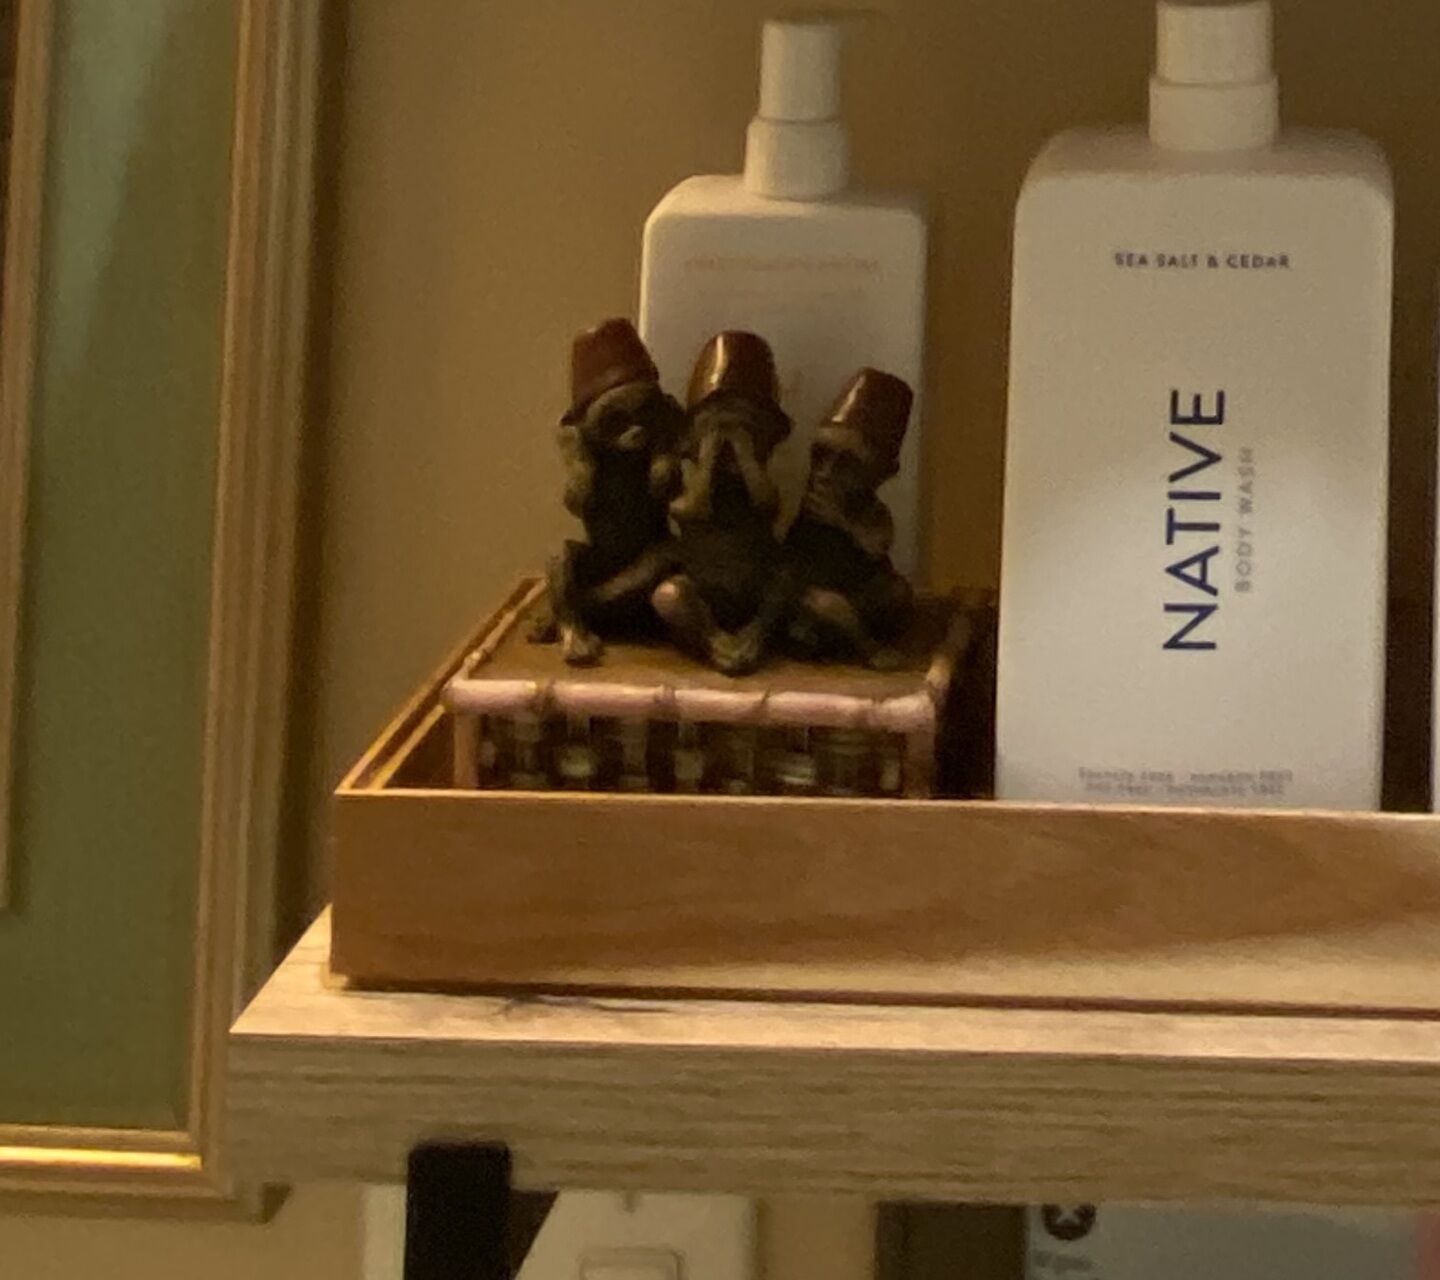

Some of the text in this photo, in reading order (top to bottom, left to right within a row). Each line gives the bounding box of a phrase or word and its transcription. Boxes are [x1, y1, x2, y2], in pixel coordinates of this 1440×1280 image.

[1115, 252, 1148, 268] SEA
[1156, 253, 1199, 269] SALT
[1226, 254, 1290, 269] CEDAR
[1162, 389, 1225, 650] NATIVE
[1234, 446, 1255, 593] BODY WASH
